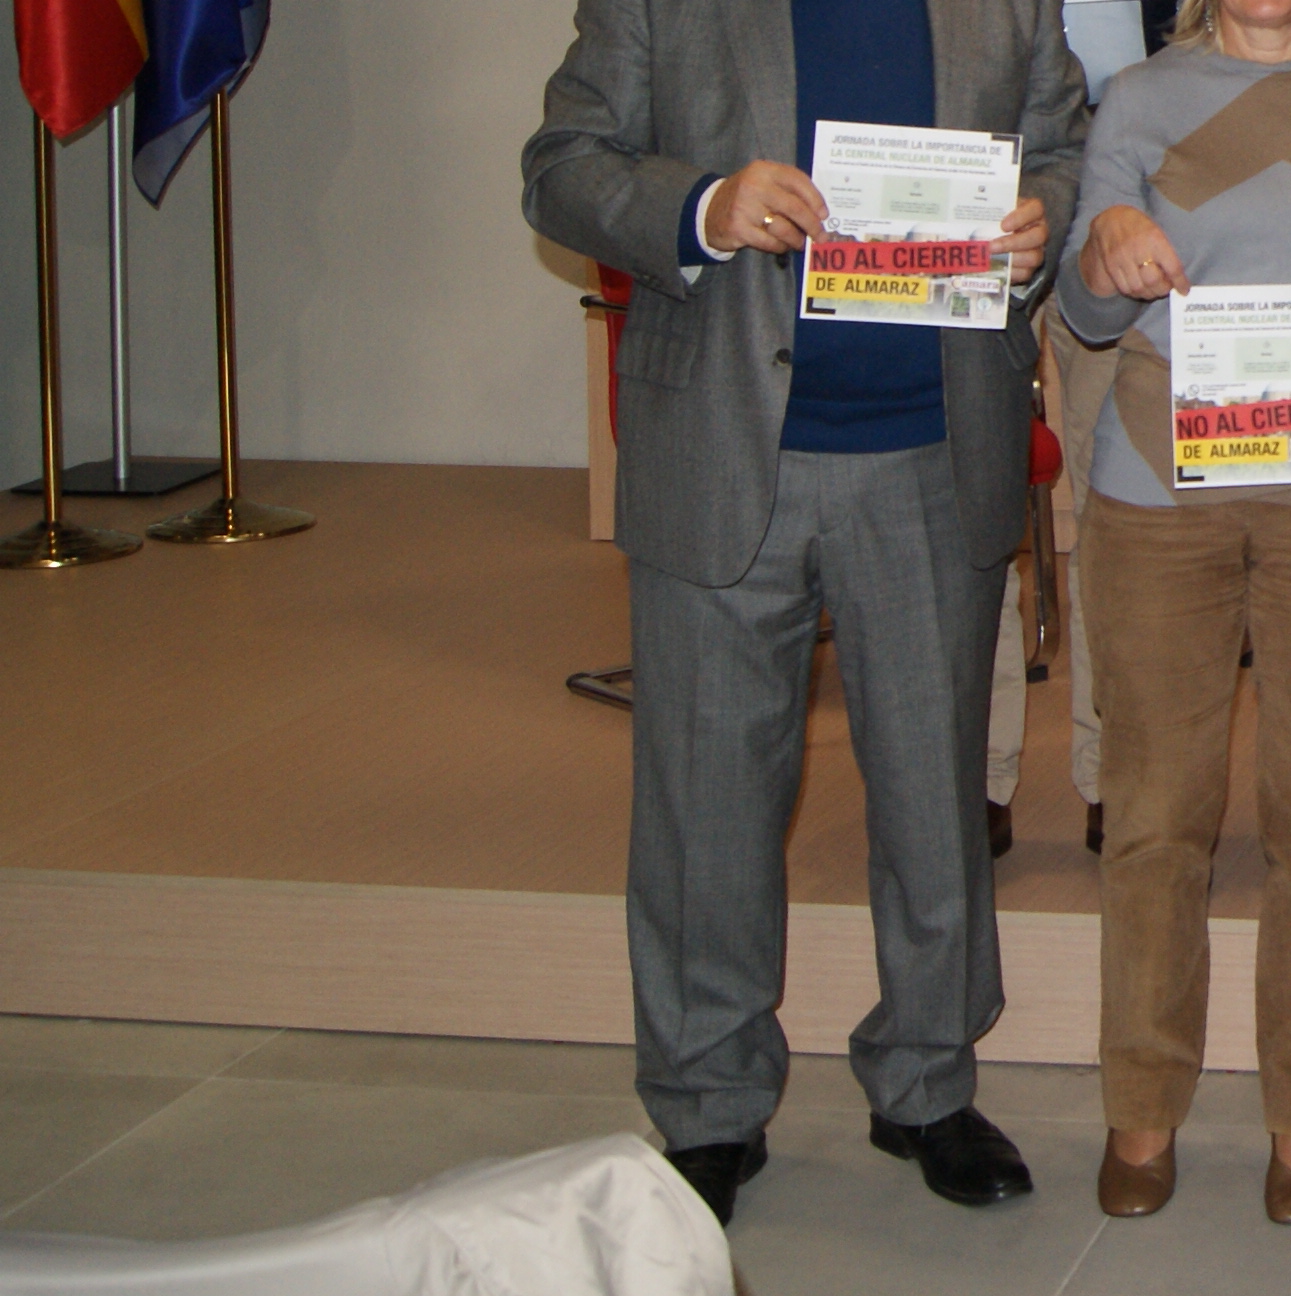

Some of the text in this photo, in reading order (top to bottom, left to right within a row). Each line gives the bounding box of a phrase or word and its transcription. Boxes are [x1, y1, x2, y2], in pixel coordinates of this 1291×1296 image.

[812, 245, 987, 271] NO AL CIERRE!
[816, 277, 920, 295] DE ALMARAZ
[1177, 416, 1208, 439] NO
[1217, 411, 1244, 433] AL
[1183, 441, 1280, 459] DE ALMARAZ
